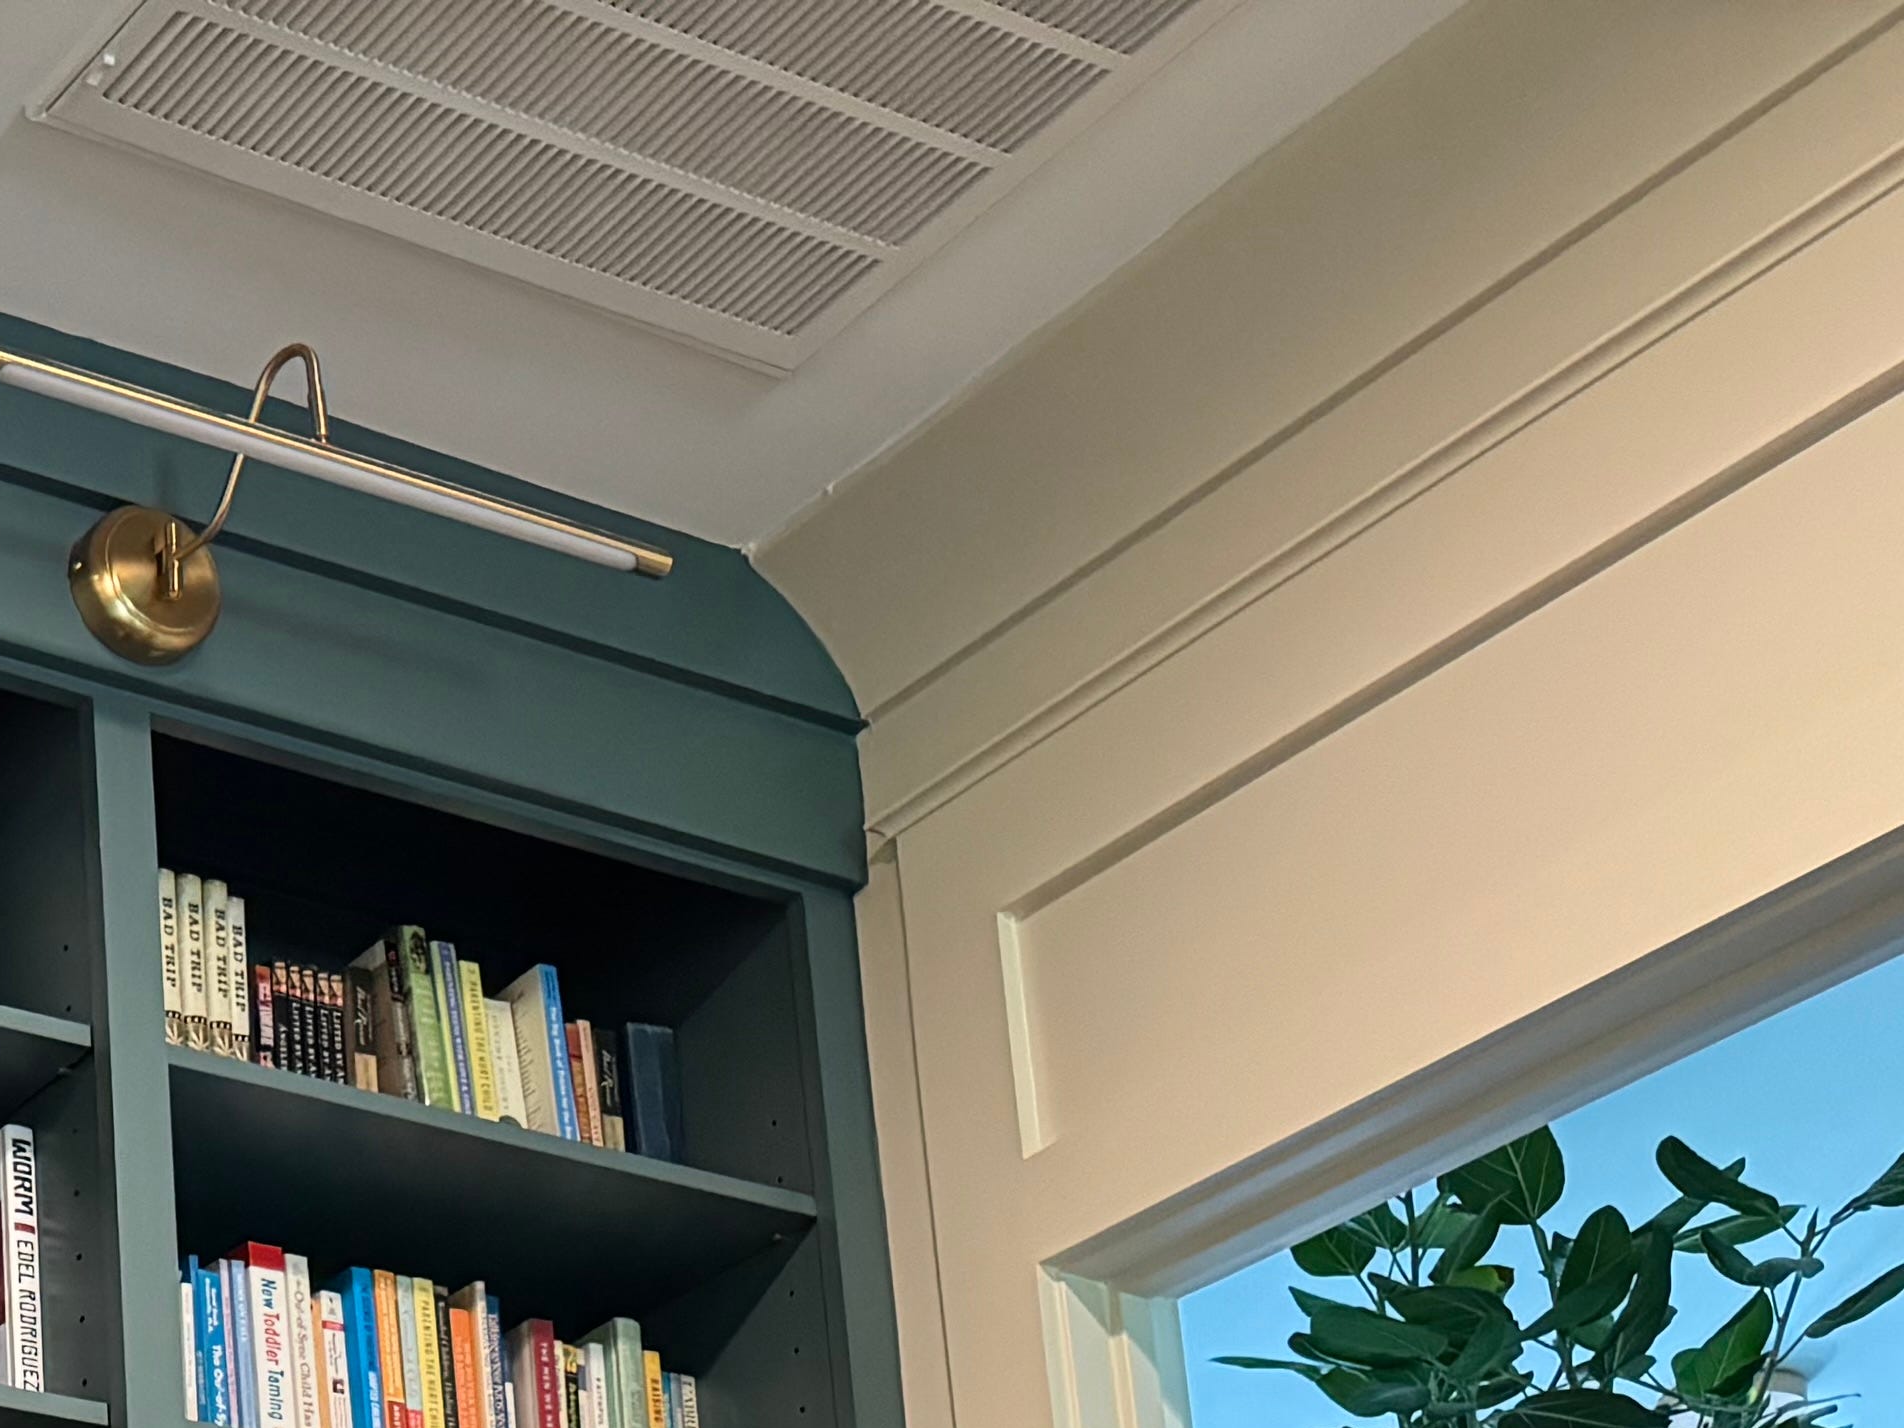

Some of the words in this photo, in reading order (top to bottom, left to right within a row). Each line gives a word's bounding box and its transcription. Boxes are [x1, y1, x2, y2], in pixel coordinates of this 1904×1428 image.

[162, 898, 173, 936] BAD
[164, 942, 177, 988] TRIP
[232, 925, 243, 962] BAD
[235, 969, 247, 1013] TRIP
[11, 1138, 33, 1216] WORM
[16, 1240, 33, 1285] EDEL
[262, 1278, 277, 1309] New
[18, 1290, 41, 1393] RODRIGUEZ
[262, 1312, 281, 1367] Toddler
[267, 1370, 284, 1421] Taming
